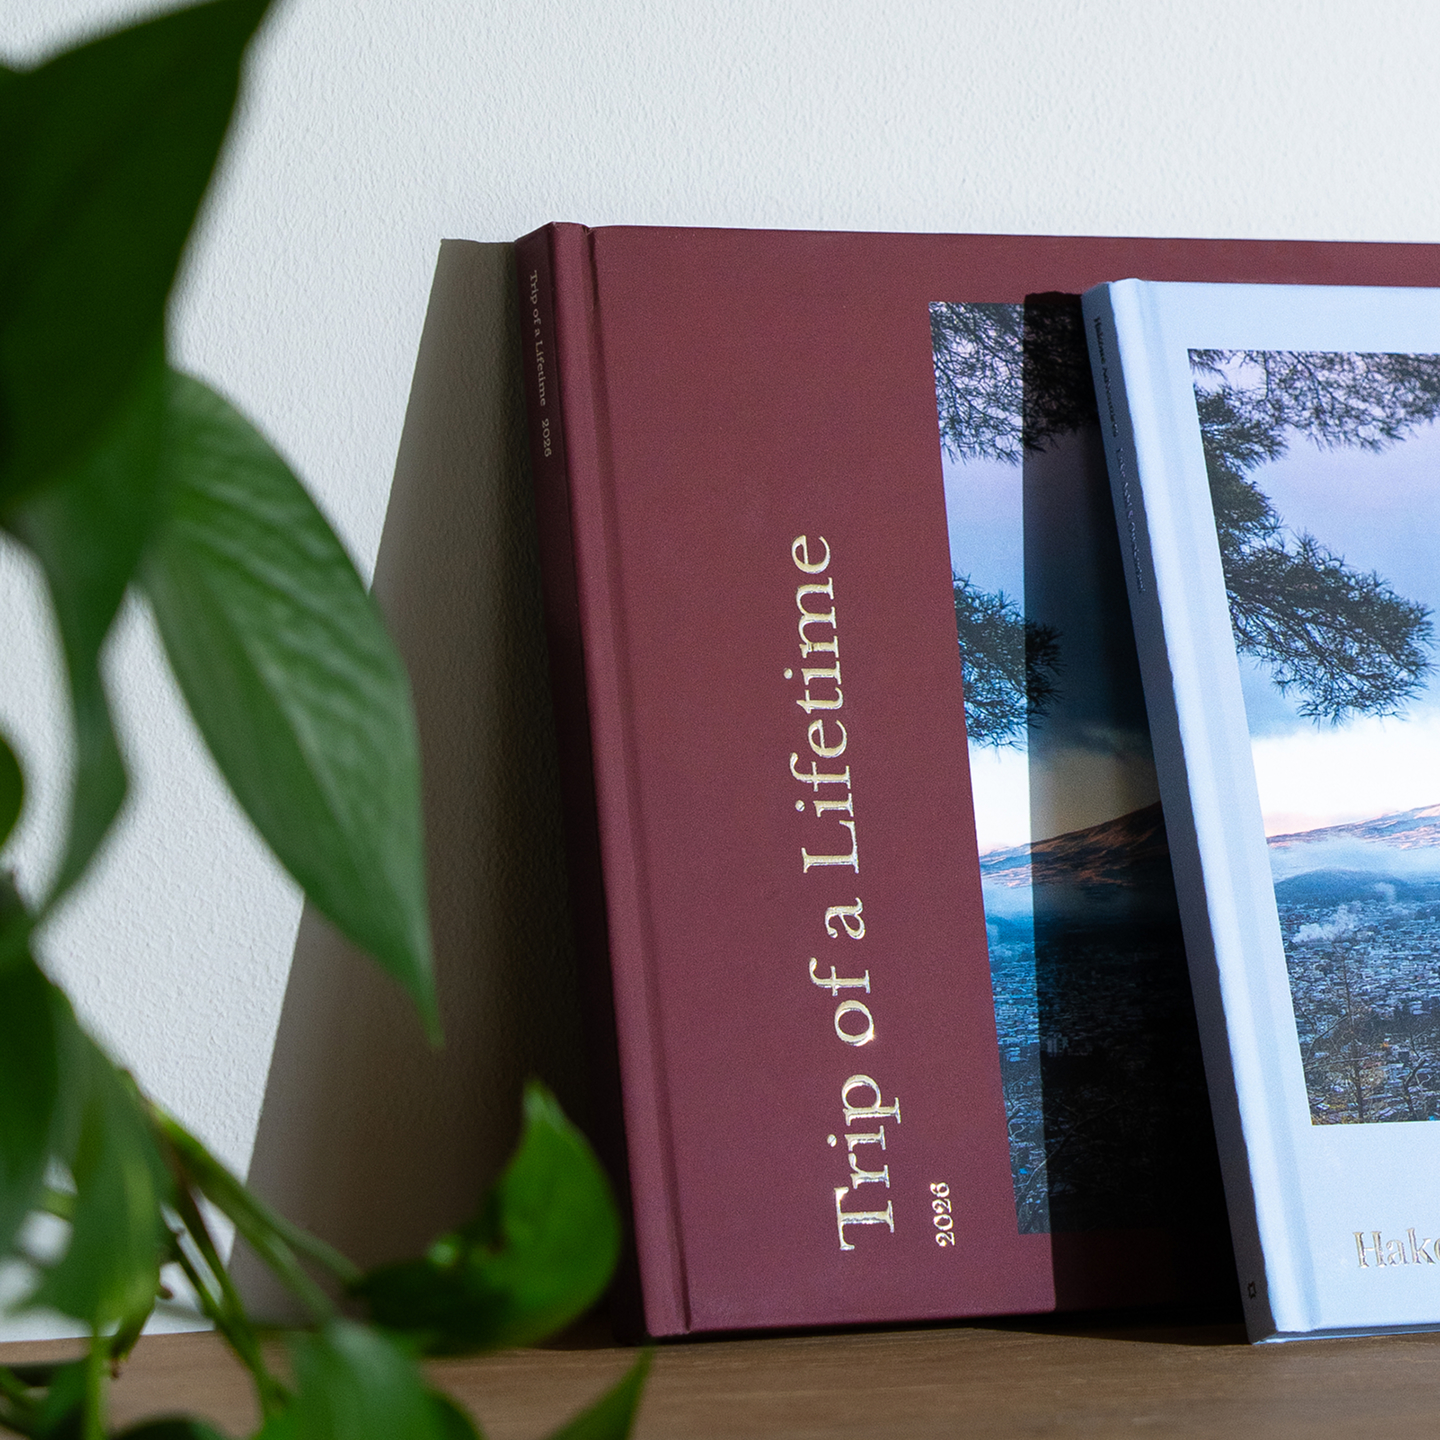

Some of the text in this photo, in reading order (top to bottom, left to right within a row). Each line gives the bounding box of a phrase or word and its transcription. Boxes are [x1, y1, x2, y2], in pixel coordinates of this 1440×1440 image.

[530, 270, 552, 457] Trip of a Lifetime 2026
[784, 534, 900, 1251] Trip of a Lifetime
[930, 1182, 956, 1248] 2026
